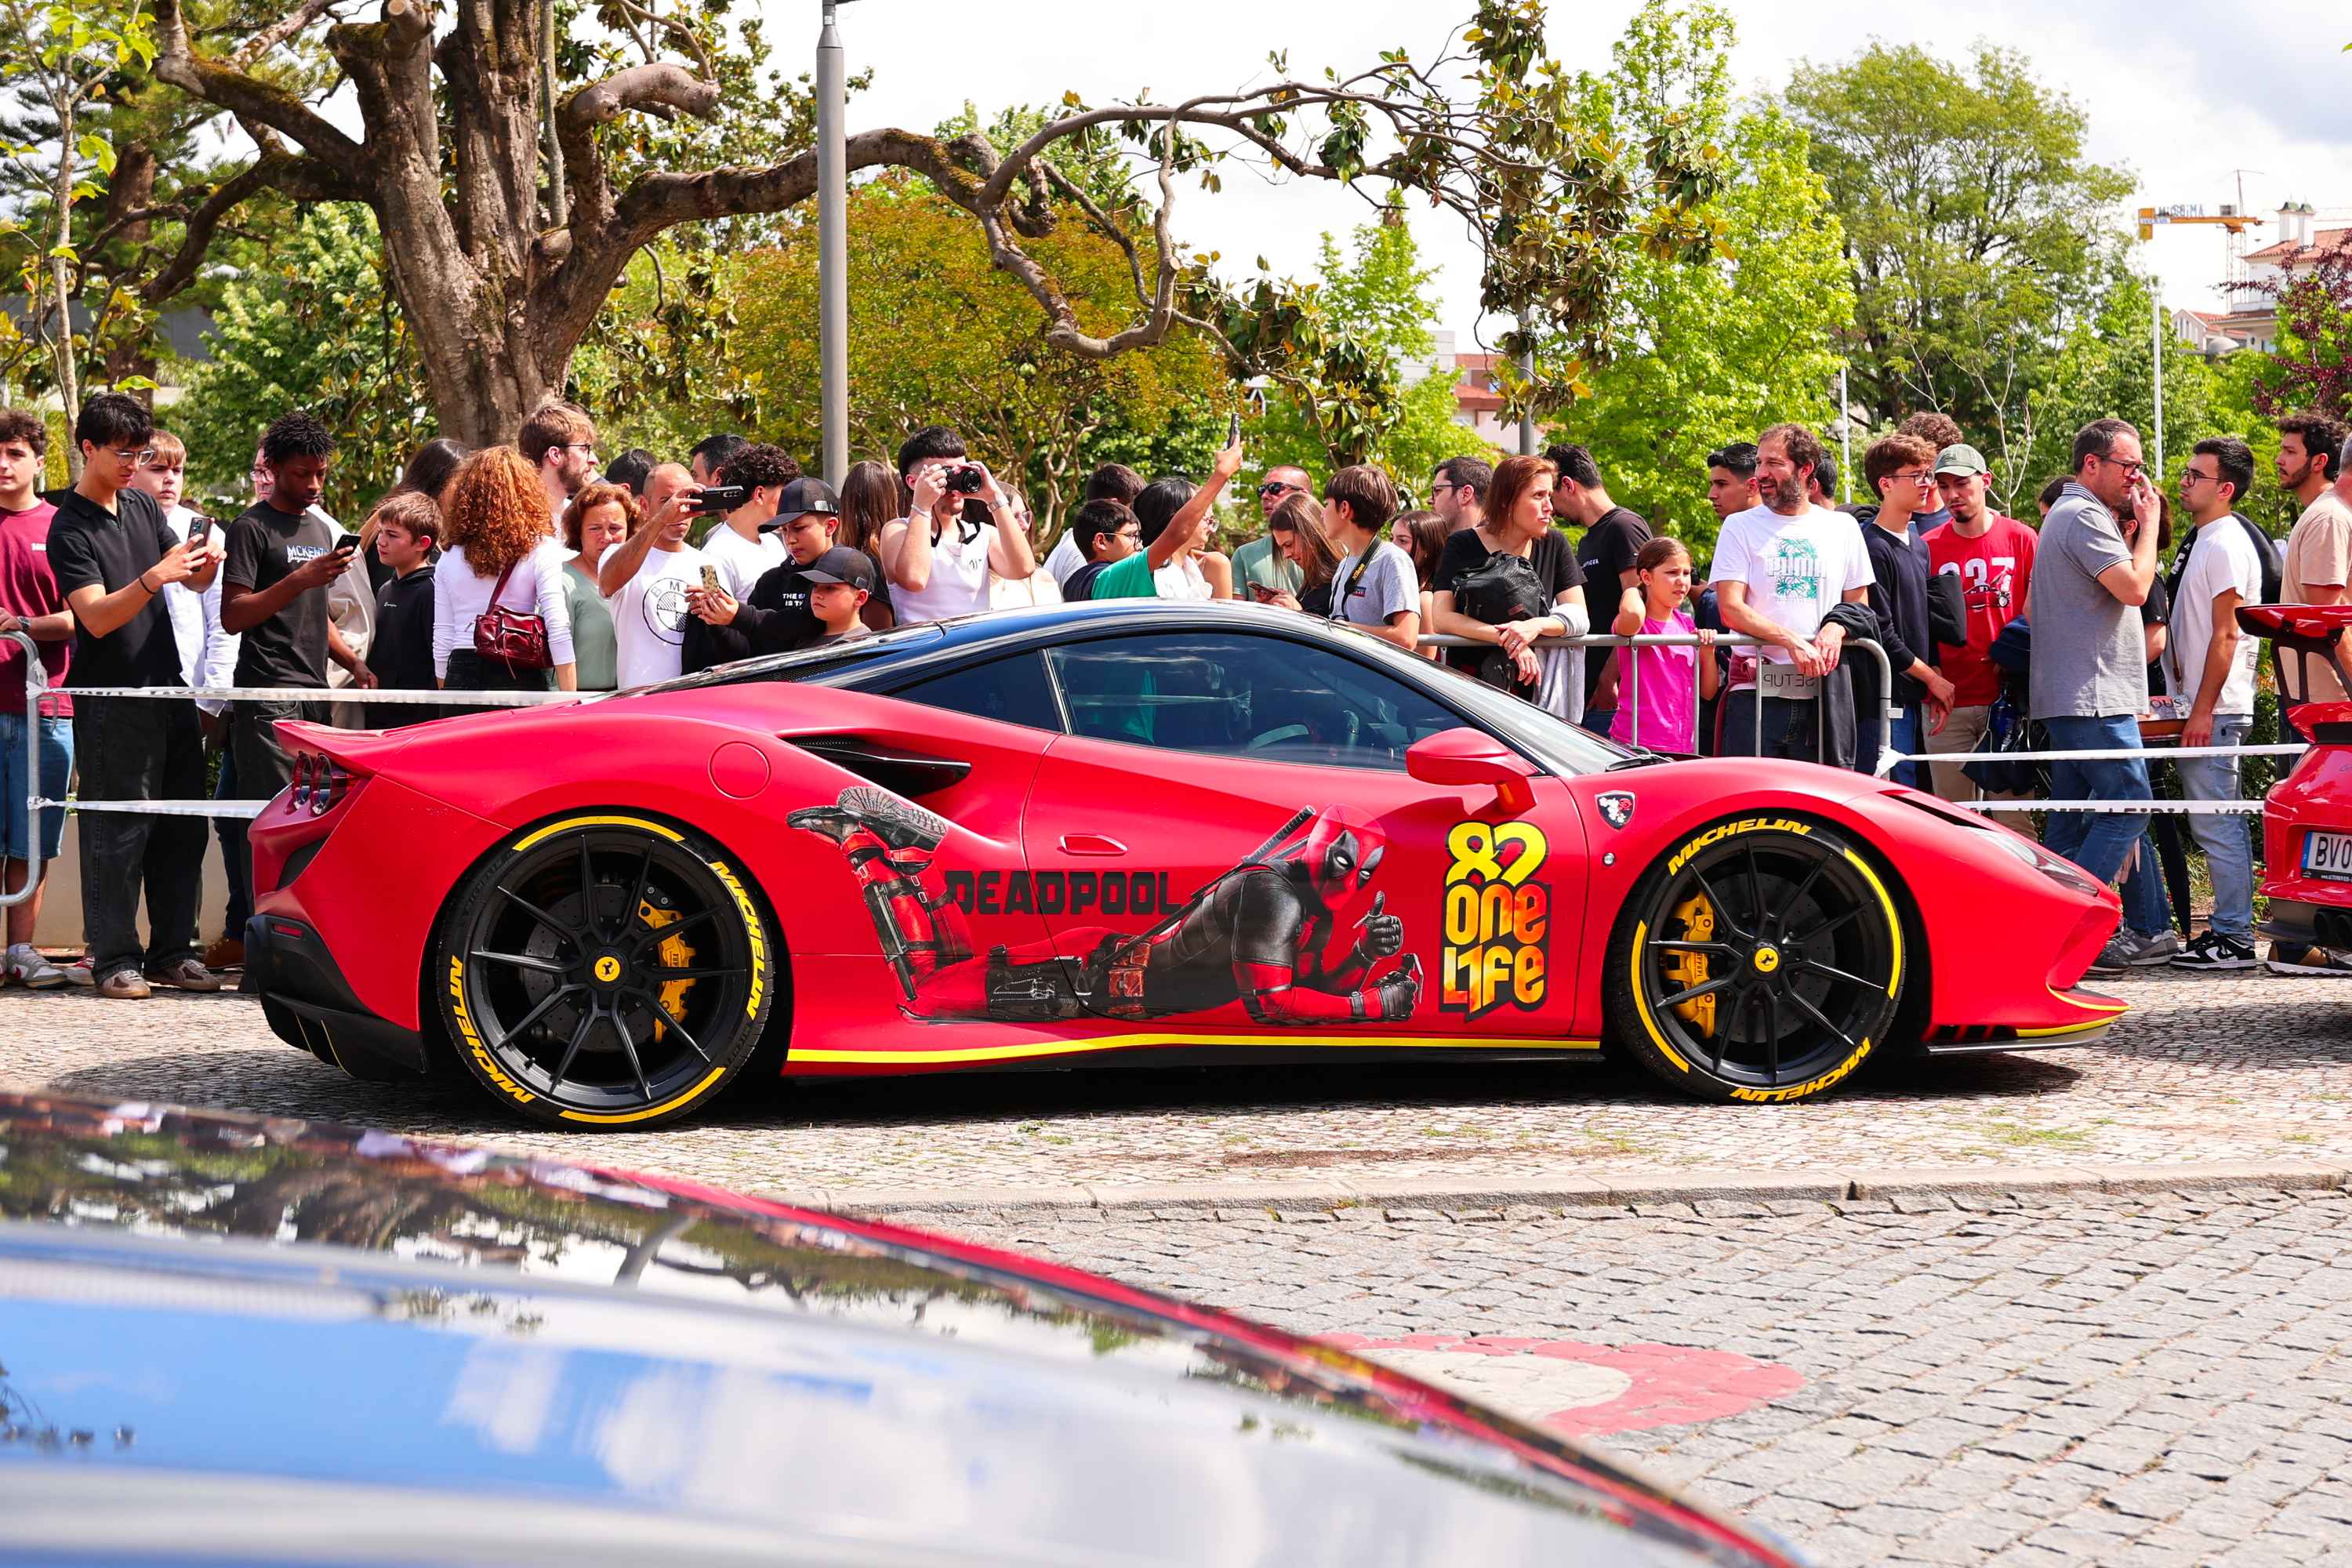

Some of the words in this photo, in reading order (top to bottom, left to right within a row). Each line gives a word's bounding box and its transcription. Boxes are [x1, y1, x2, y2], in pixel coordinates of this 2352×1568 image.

[1768, 557, 1826, 579] PUMA
[1446, 821, 1548, 888] 82
[1668, 818, 1812, 877] MICHELIN
[945, 870, 1181, 915] DEADPOOL
[710, 861, 764, 1020] MICHELIN
[449, 955, 535, 1103] MICHELIN
[1730, 1037, 1871, 1102] MICHELIN
